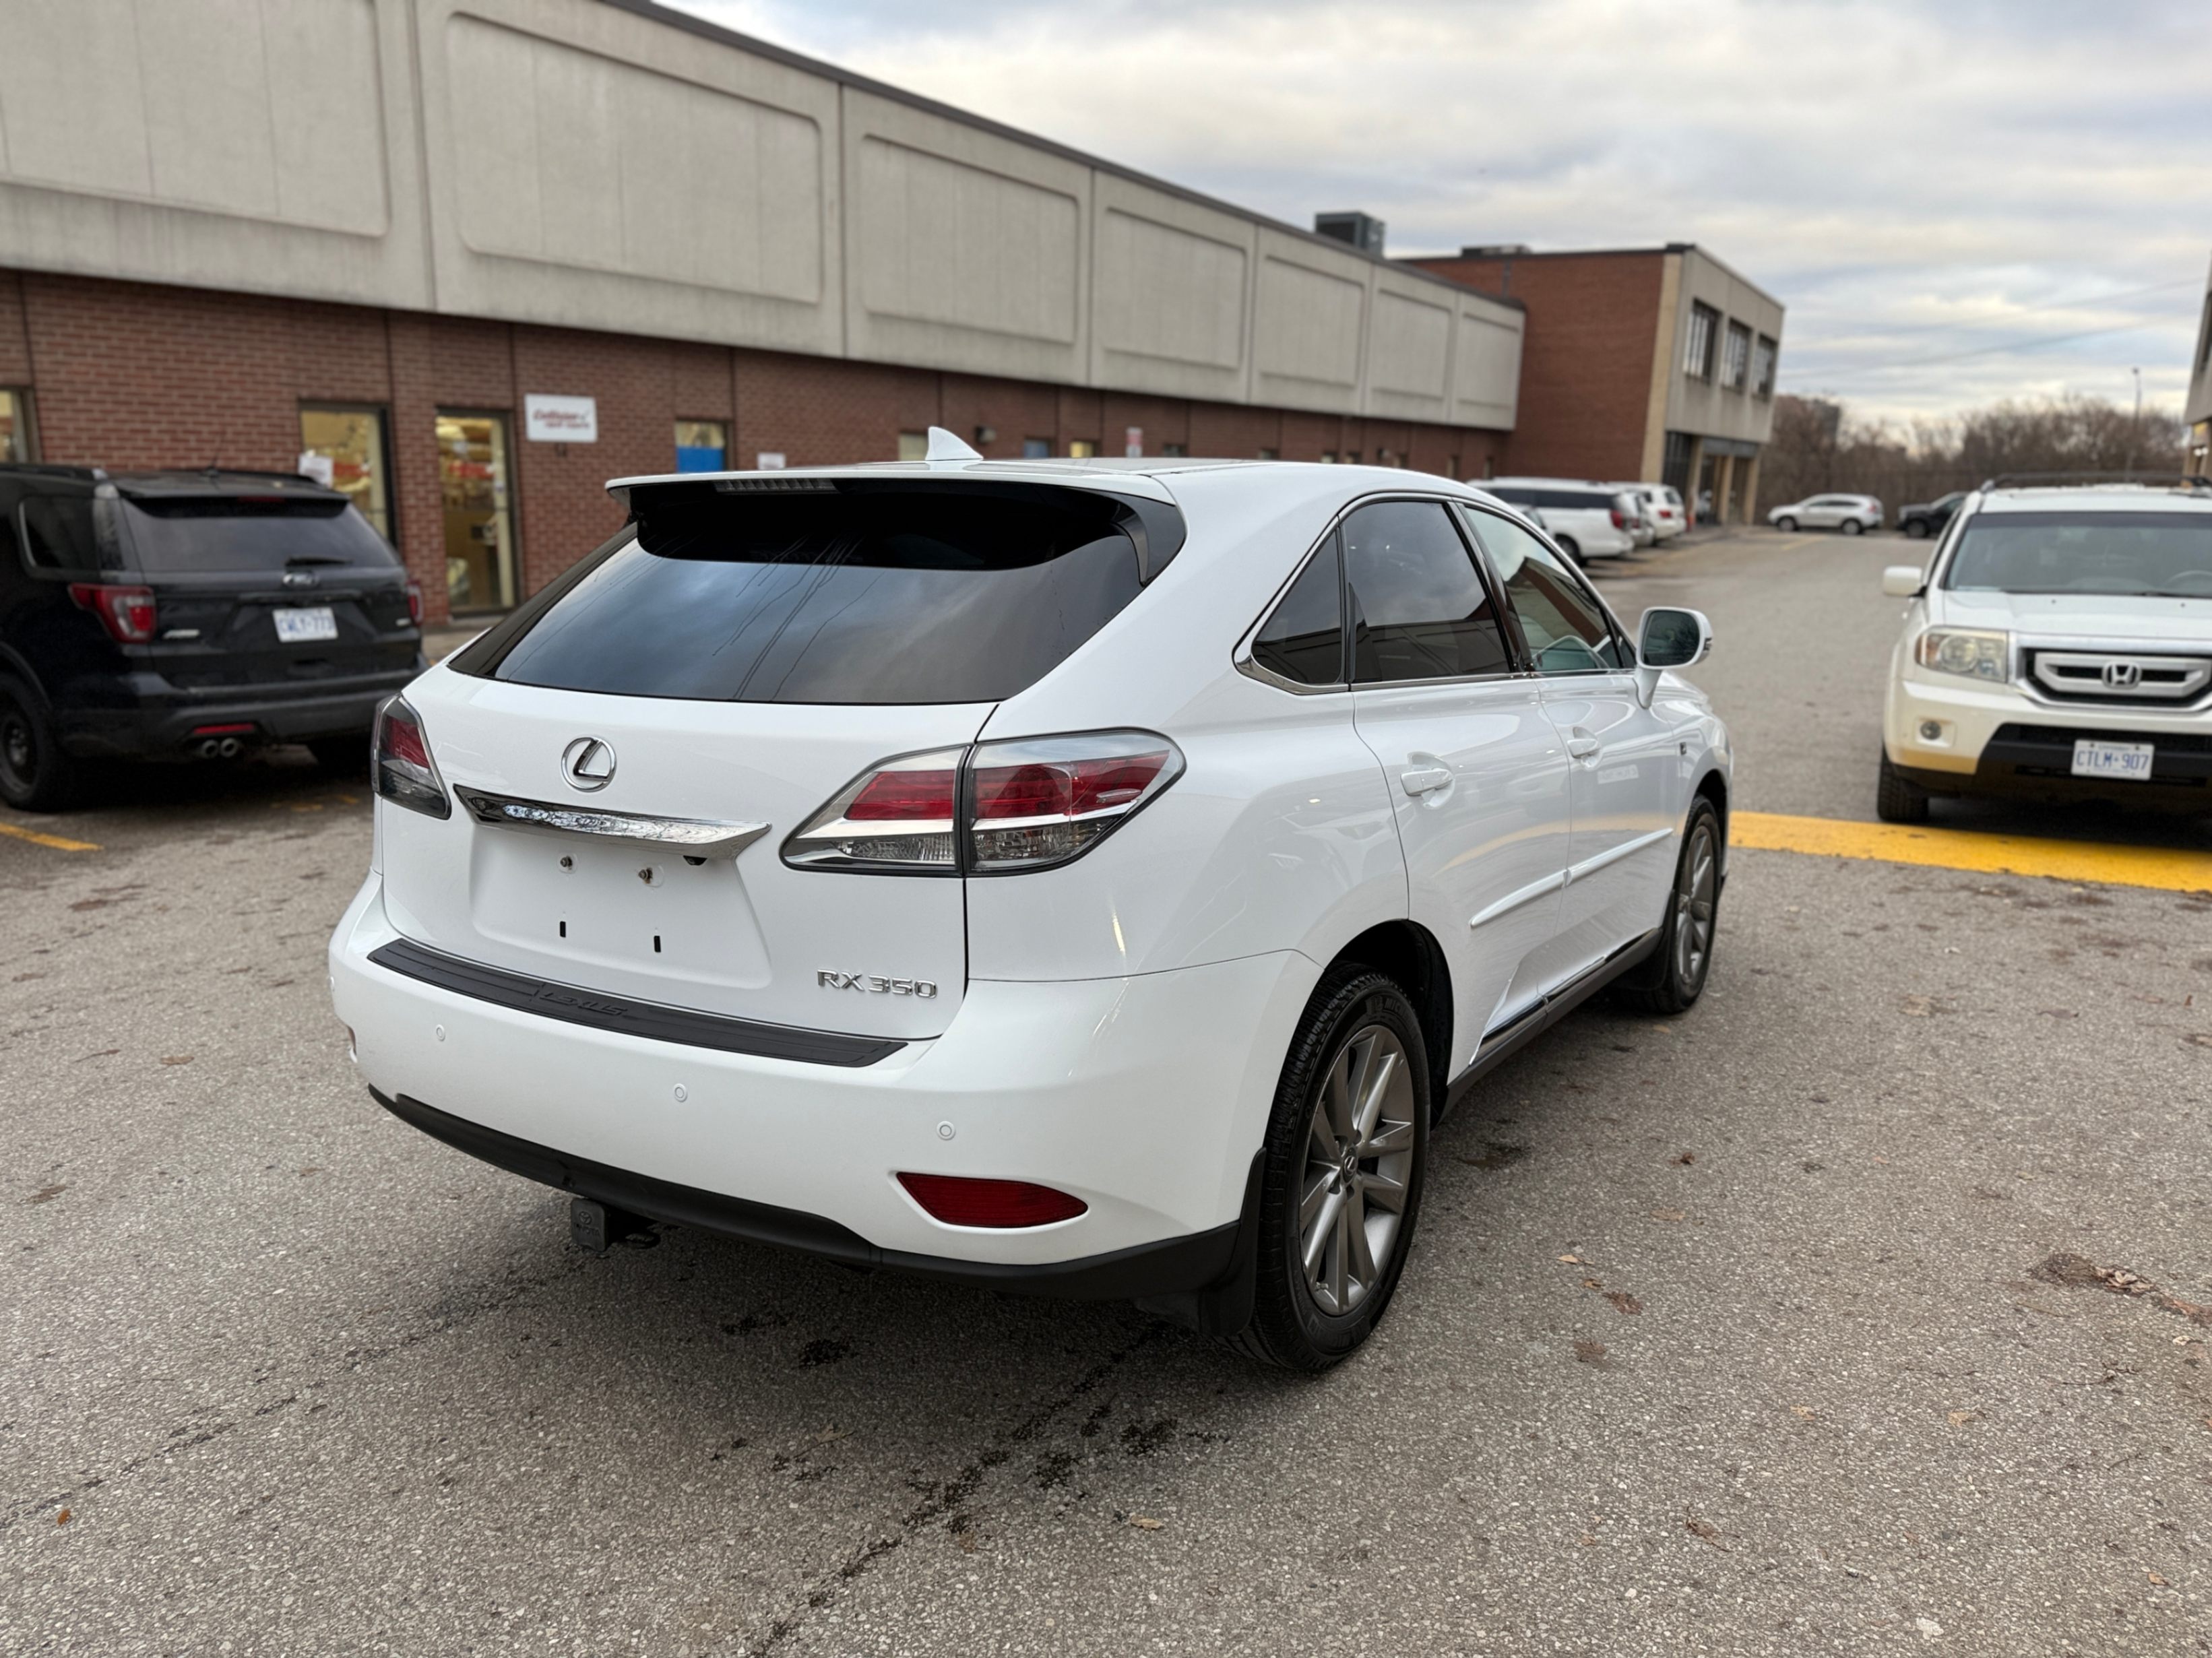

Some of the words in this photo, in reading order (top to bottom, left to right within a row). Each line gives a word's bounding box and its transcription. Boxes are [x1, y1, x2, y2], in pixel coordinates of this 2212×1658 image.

[817, 969, 865, 992] RX
[868, 974, 939, 999] 350
[539, 992, 629, 1017] LEXUS
